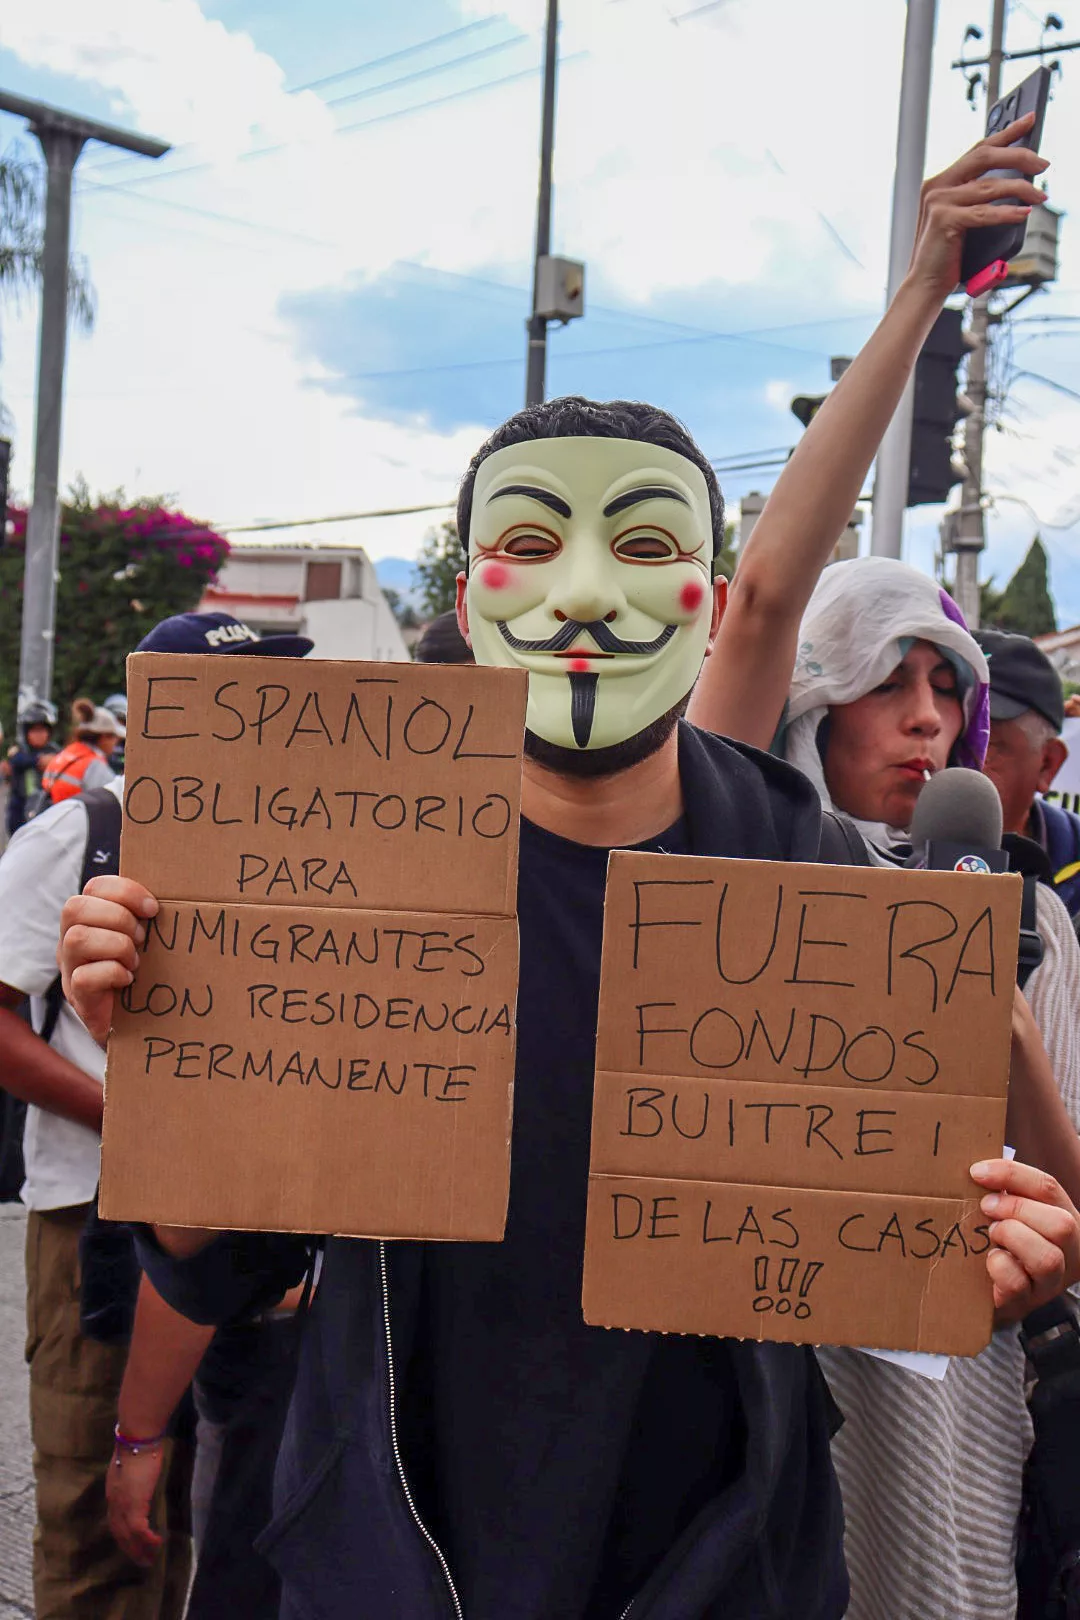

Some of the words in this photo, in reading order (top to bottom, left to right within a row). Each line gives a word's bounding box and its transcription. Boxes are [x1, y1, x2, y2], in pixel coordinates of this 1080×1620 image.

[141, 676, 517, 760] ESPAÑOL
[125, 776, 511, 838] OBLIGATORIO
[236, 853, 358, 897] PARA
[143, 908, 485, 976] NMIGRANTES
[628, 879, 996, 1013] FUERA
[120, 979, 213, 1017] CON
[246, 983, 512, 1036] RESIDENCIA
[143, 1036, 477, 1102] PERMANENTE
[635, 1002, 940, 1086] FONDOS
[619, 1087, 898, 1160] BUITRE
[610, 1193, 681, 1240] DE
[702, 1200, 801, 1249] LAS
[837, 1211, 991, 1259] CASAS
